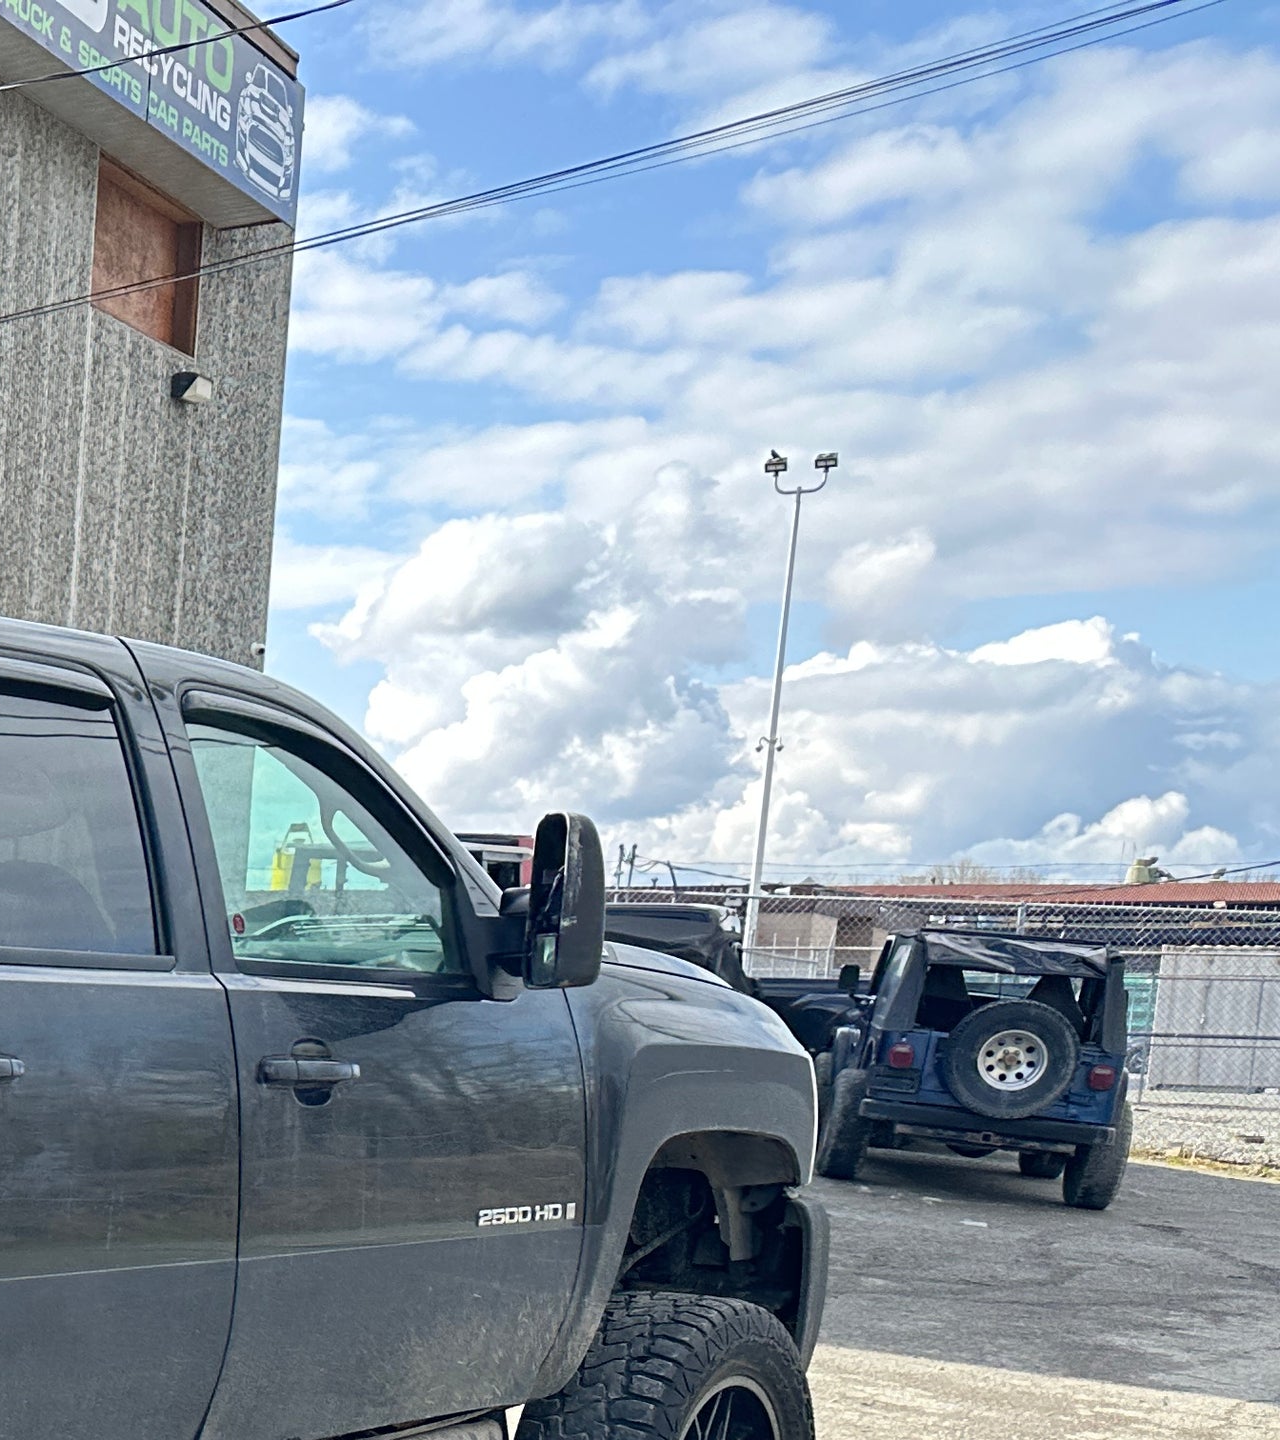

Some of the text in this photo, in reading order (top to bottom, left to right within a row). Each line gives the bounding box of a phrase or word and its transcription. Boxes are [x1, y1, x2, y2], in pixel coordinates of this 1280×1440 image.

[0, 0, 228, 167] RUCK & SPORTS CAR PARTS
[113, 14, 232, 132] RECYCLING
[478, 1203, 562, 1227] 2500 HD
